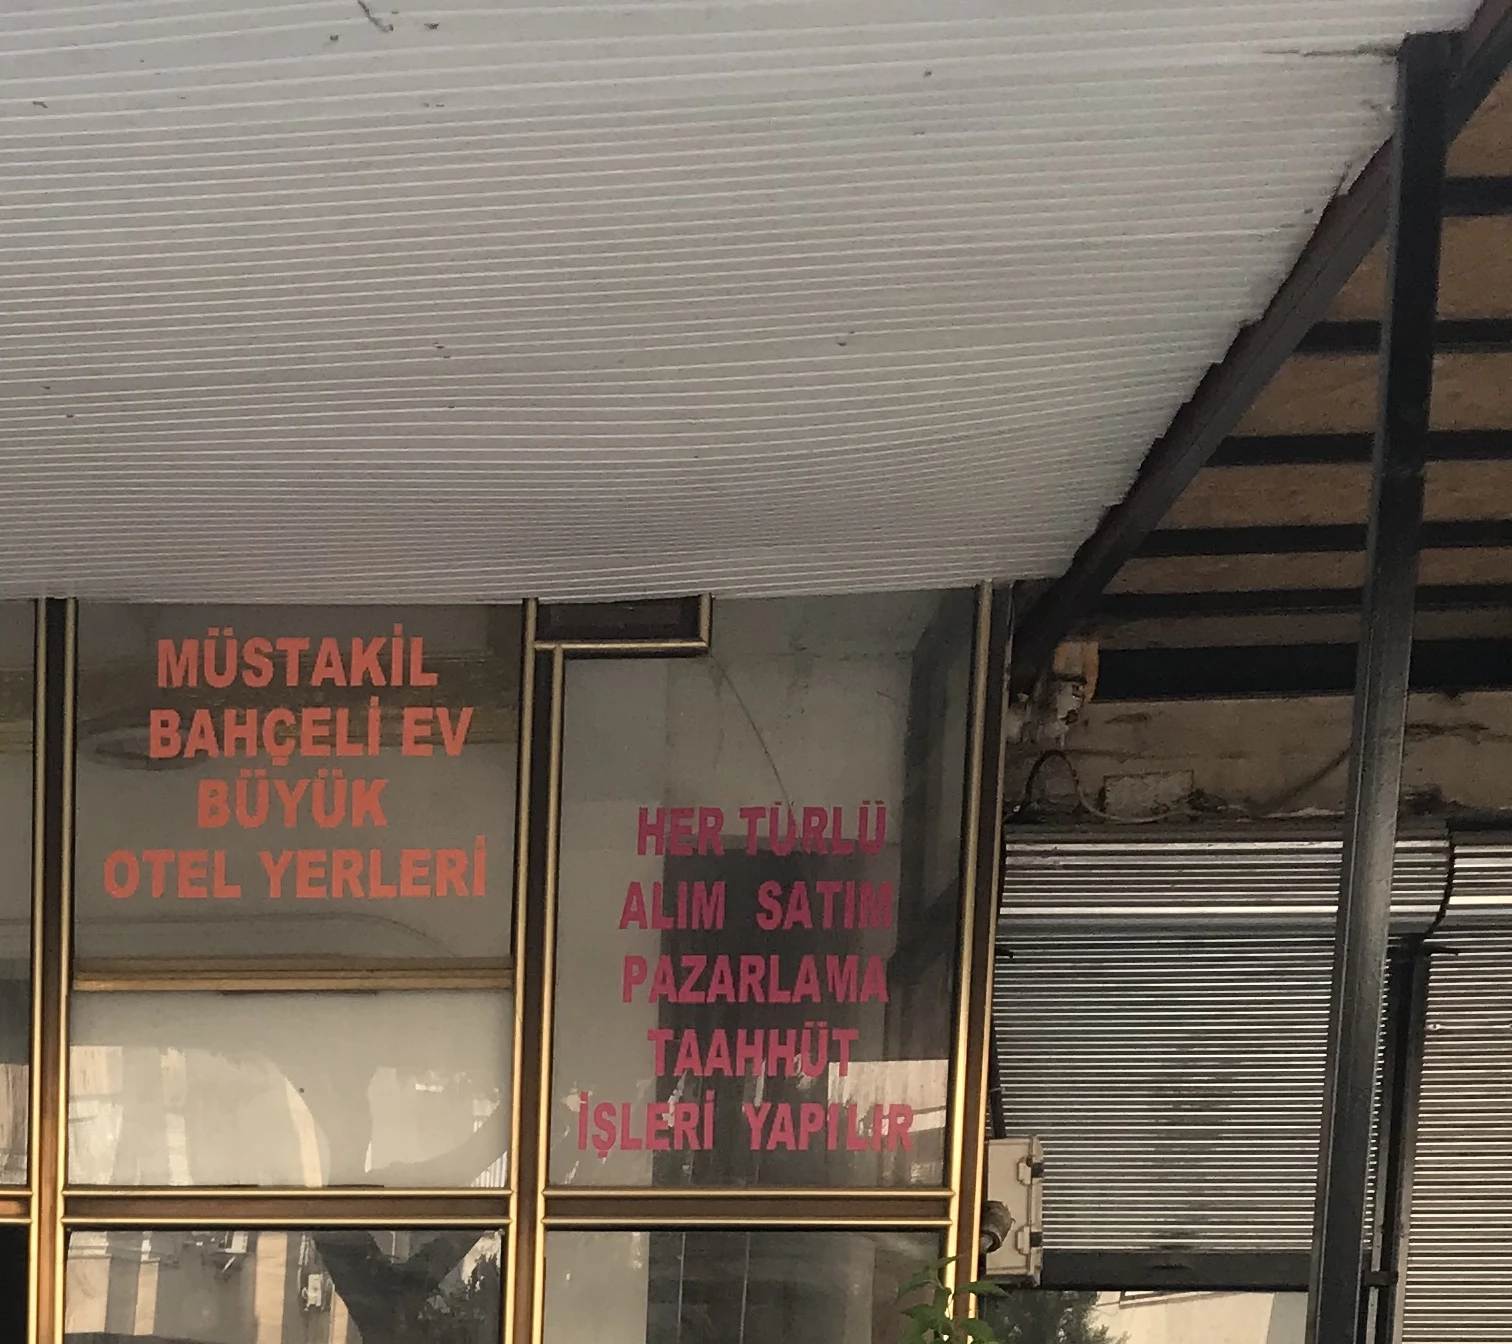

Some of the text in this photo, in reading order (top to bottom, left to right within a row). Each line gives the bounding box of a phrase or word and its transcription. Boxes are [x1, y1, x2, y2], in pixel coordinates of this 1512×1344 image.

[157, 623, 438, 689] MÜSTAKİL
[148, 696, 473, 767] BAHÇELİ EV
[197, 769, 387, 829] BÜYÜK
[636, 799, 887, 856] HER TÜRLÜ
[103, 835, 487, 900] OTEL YERLERİ
[619, 880, 892, 931] ALIM SATIM
[622, 953, 889, 1005] PAZARLAMA
[647, 1020, 859, 1078] TAAHHÜT
[578, 1090, 914, 1159] İŞLERİ YAPILIR
